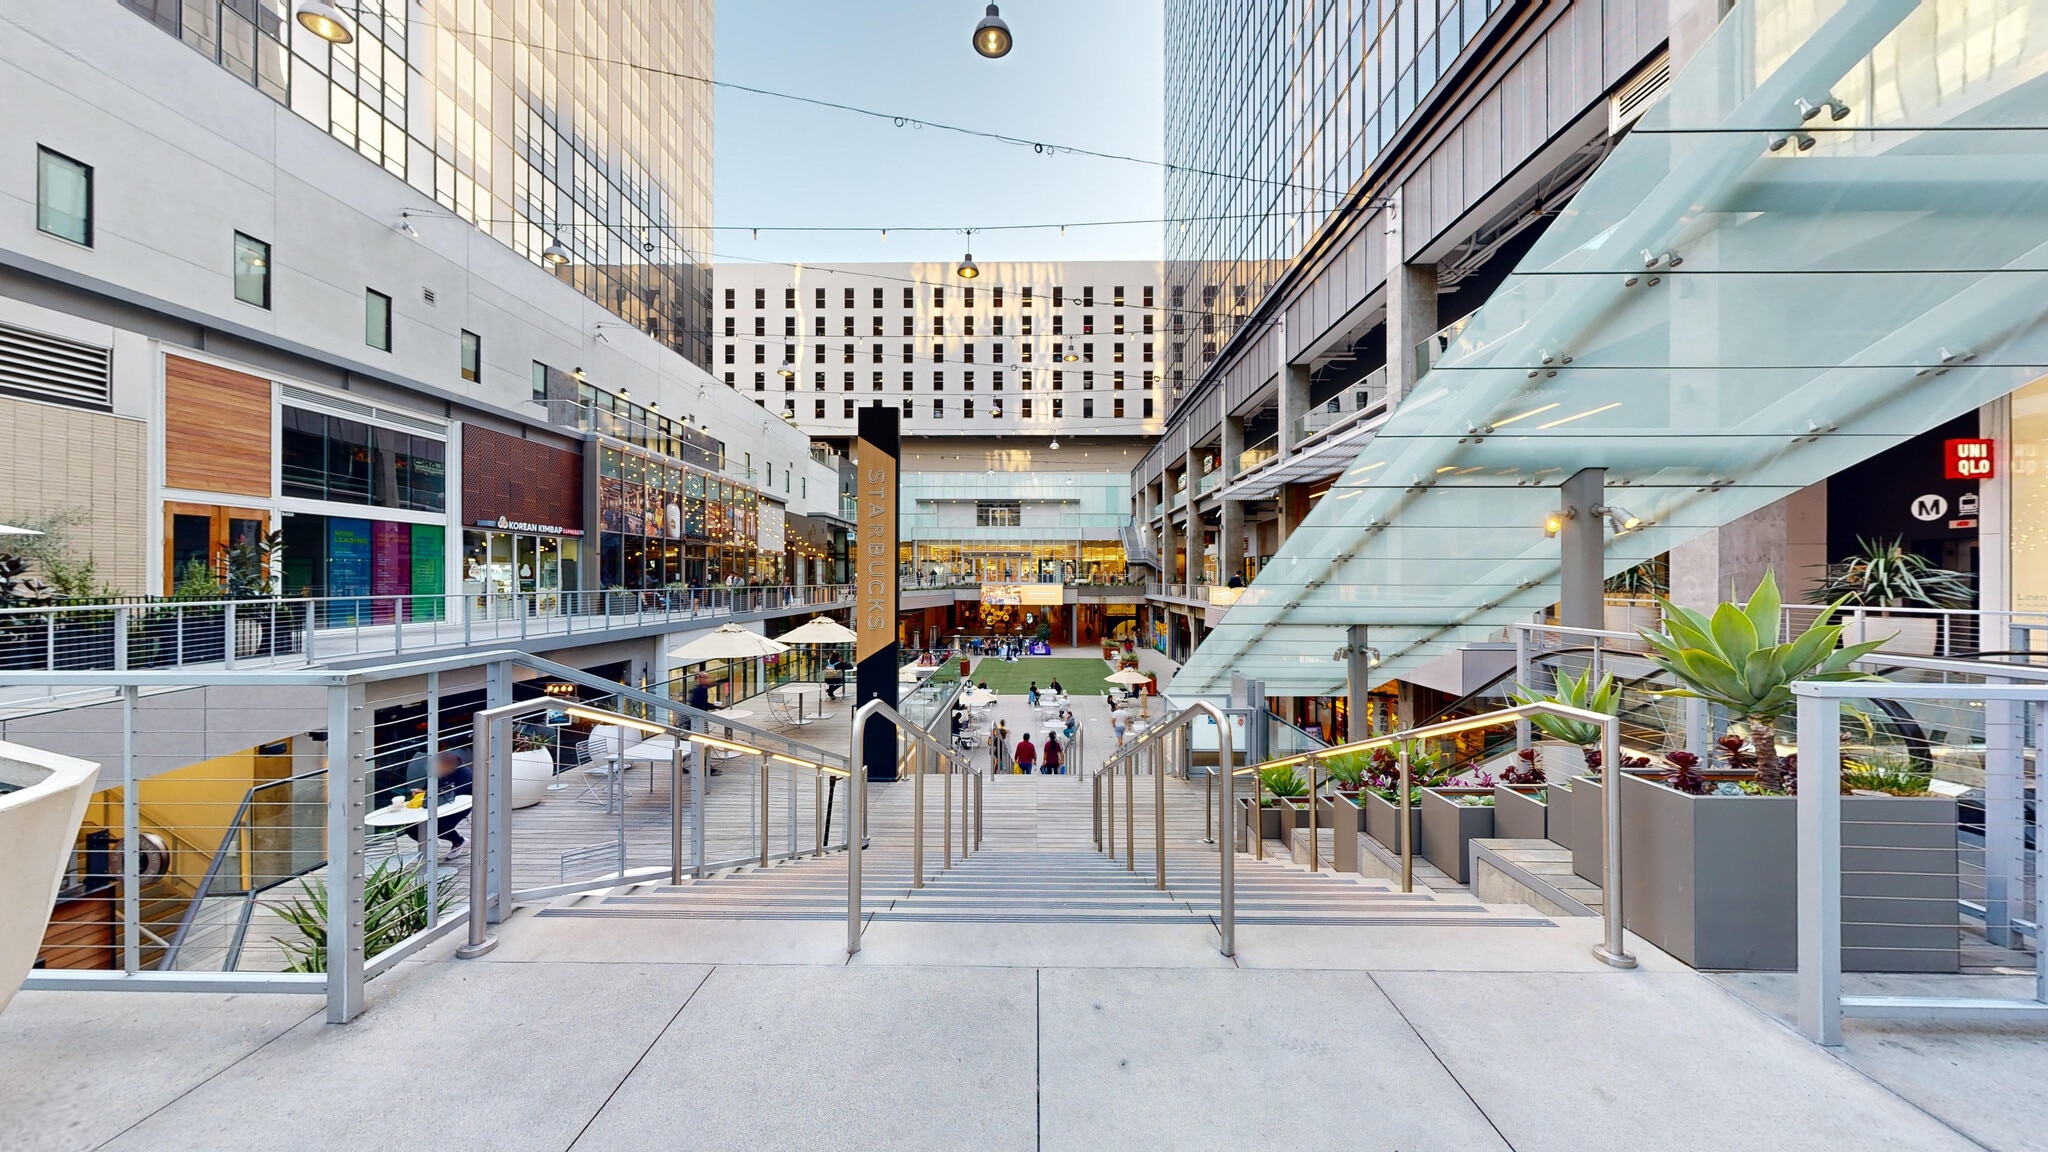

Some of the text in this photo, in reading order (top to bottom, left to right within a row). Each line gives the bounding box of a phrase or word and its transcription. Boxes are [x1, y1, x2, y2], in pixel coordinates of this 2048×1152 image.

[1957, 443, 1988, 458] UNI
[1957, 459, 1990, 476] QLO
[1918, 498, 1941, 517] M
[508, 521, 537, 532] KOREAN
[538, 524, 563, 535] KIMBAP
[333, 536, 369, 545] LEASING
[867, 468, 885, 631] STARBUCKS
